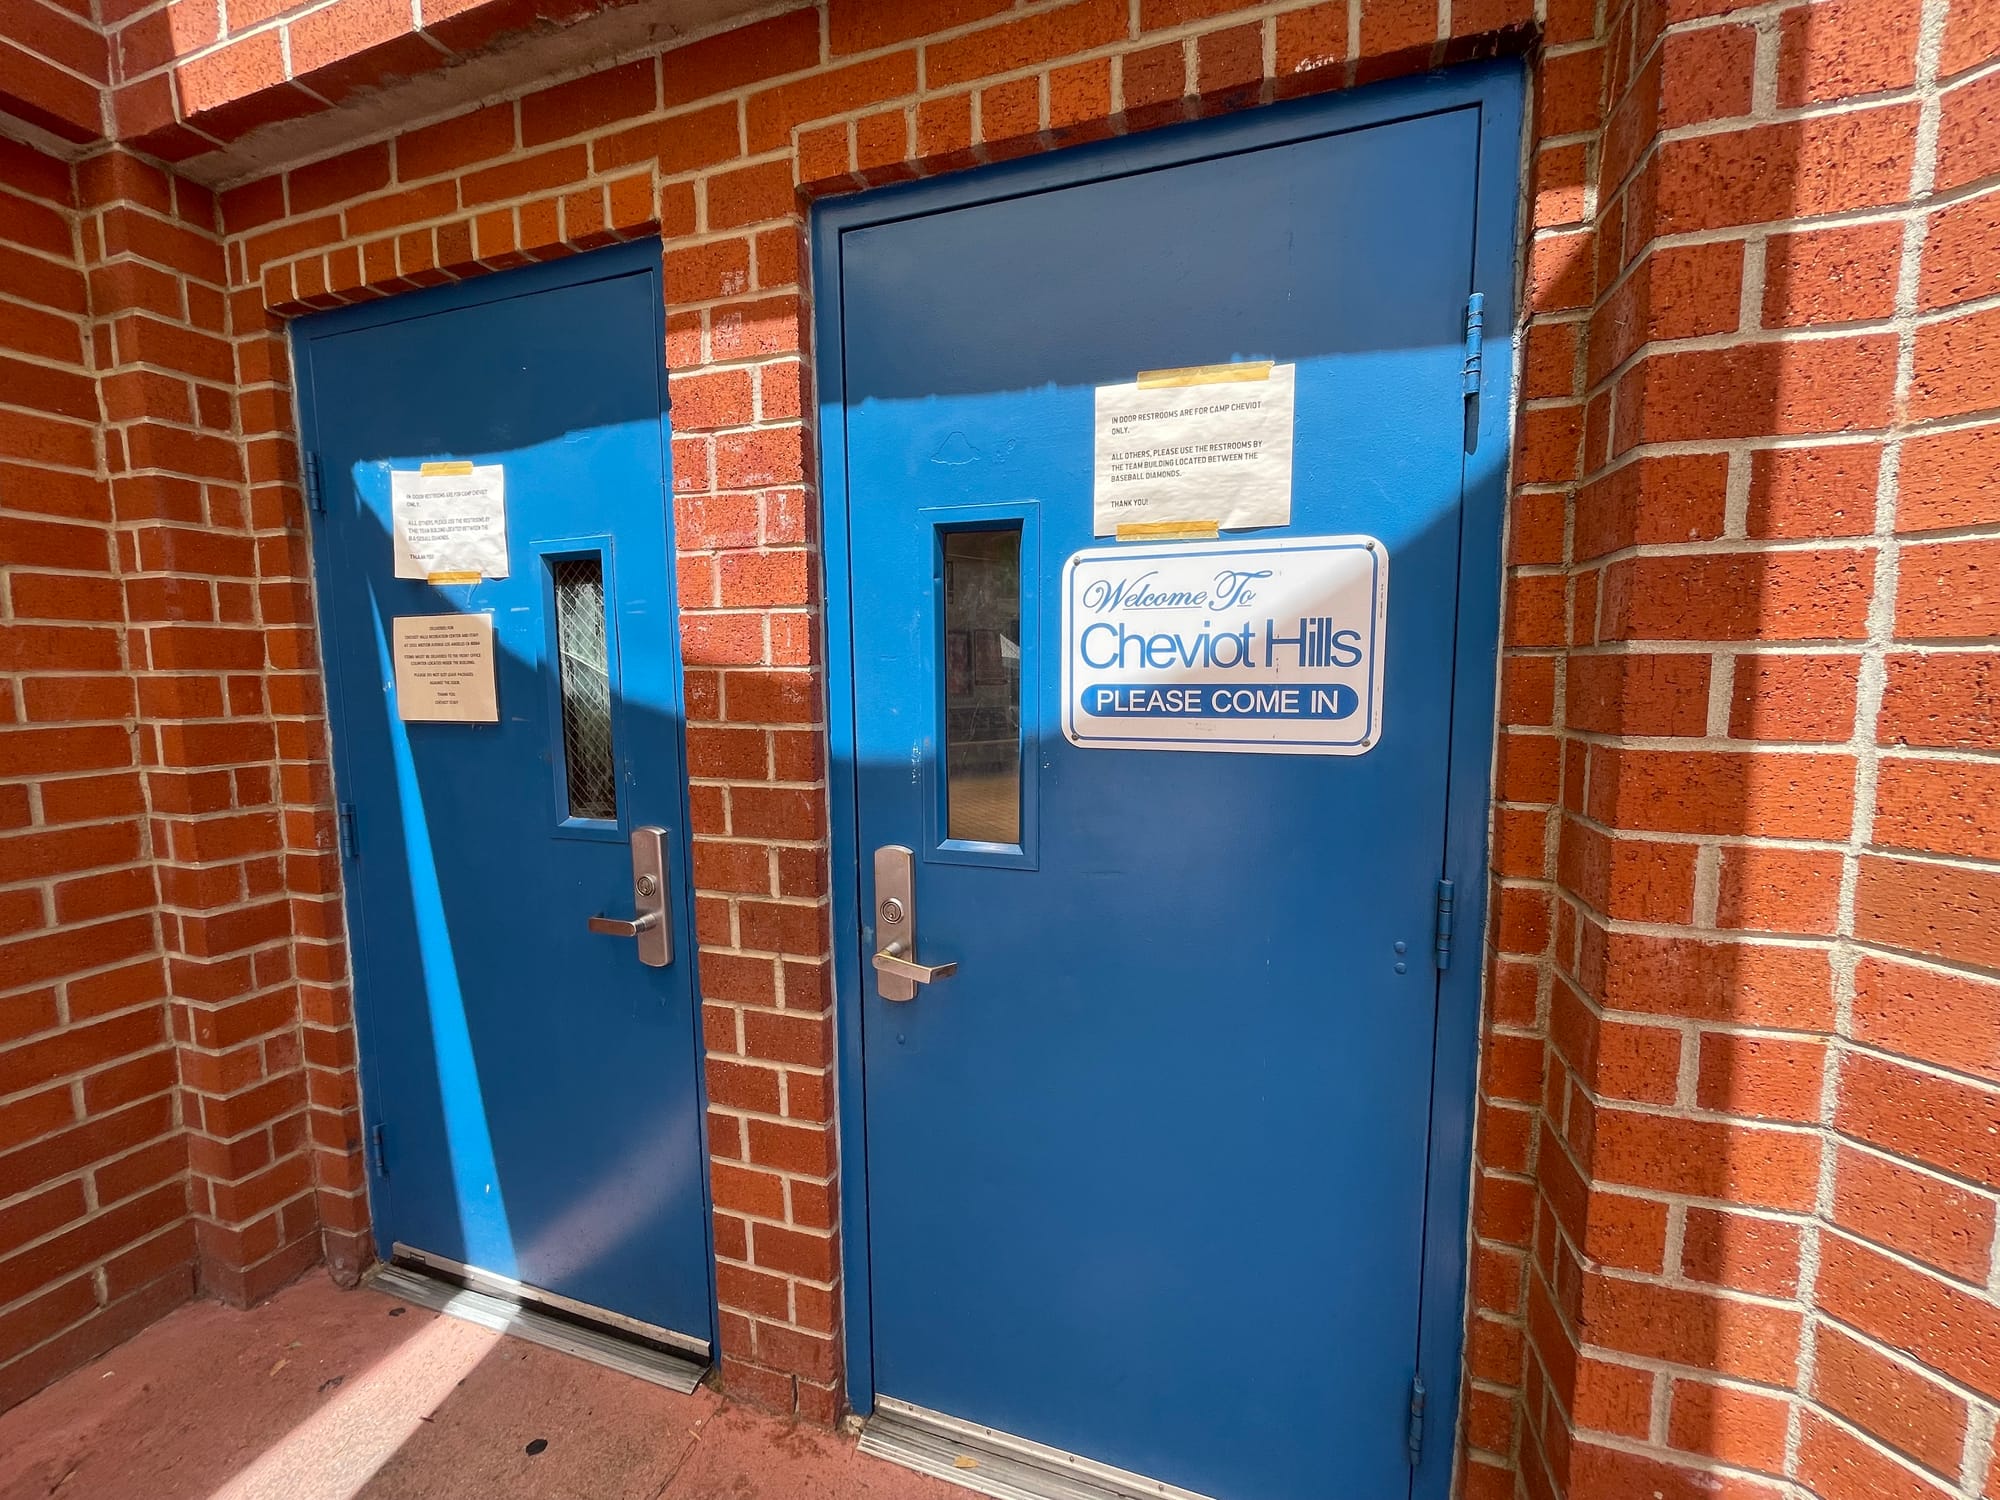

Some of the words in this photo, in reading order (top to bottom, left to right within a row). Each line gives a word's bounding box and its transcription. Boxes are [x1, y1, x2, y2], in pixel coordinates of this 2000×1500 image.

[1119, 414, 1137, 424] DOOR
[1138, 410, 1179, 421] RESTROOMS
[1180, 408, 1194, 417] ARE
[1194, 406, 1208, 415] FOR
[1209, 404, 1230, 414] CAMP
[1230, 400, 1262, 411] CHEVIOT
[1111, 426, 1130, 435] ONLY.
[1124, 450, 1152, 460] OTHERS,
[1152, 447, 1179, 456] PLEASE
[1180, 446, 1194, 454] USE
[1195, 444, 1208, 453] THE
[1209, 441, 1252, 452] RESTROOMS
[1112, 464, 1124, 472] THE
[1125, 462, 1143, 470] TEAM
[1144, 459, 1174, 468] BUILDING
[1175, 456, 1207, 466] LOCATED
[1207, 453, 1243, 463] BETWEEN
[1244, 452, 1258, 460] THE
[1110, 473, 1144, 482] BASEBALL
[1145, 470, 1182, 480] DIAMONDS.
[1111, 499, 1132, 508] THANK
[1082, 570, 1206, 614] Welcome
[1208, 570, 1274, 611] To
[1080, 620, 1256, 670] Cheviot
[1265, 617, 1362, 668] Hills
[1097, 690, 1202, 712] PLEASE
[1211, 690, 1299, 714] COME
[1311, 690, 1338, 714] IN
